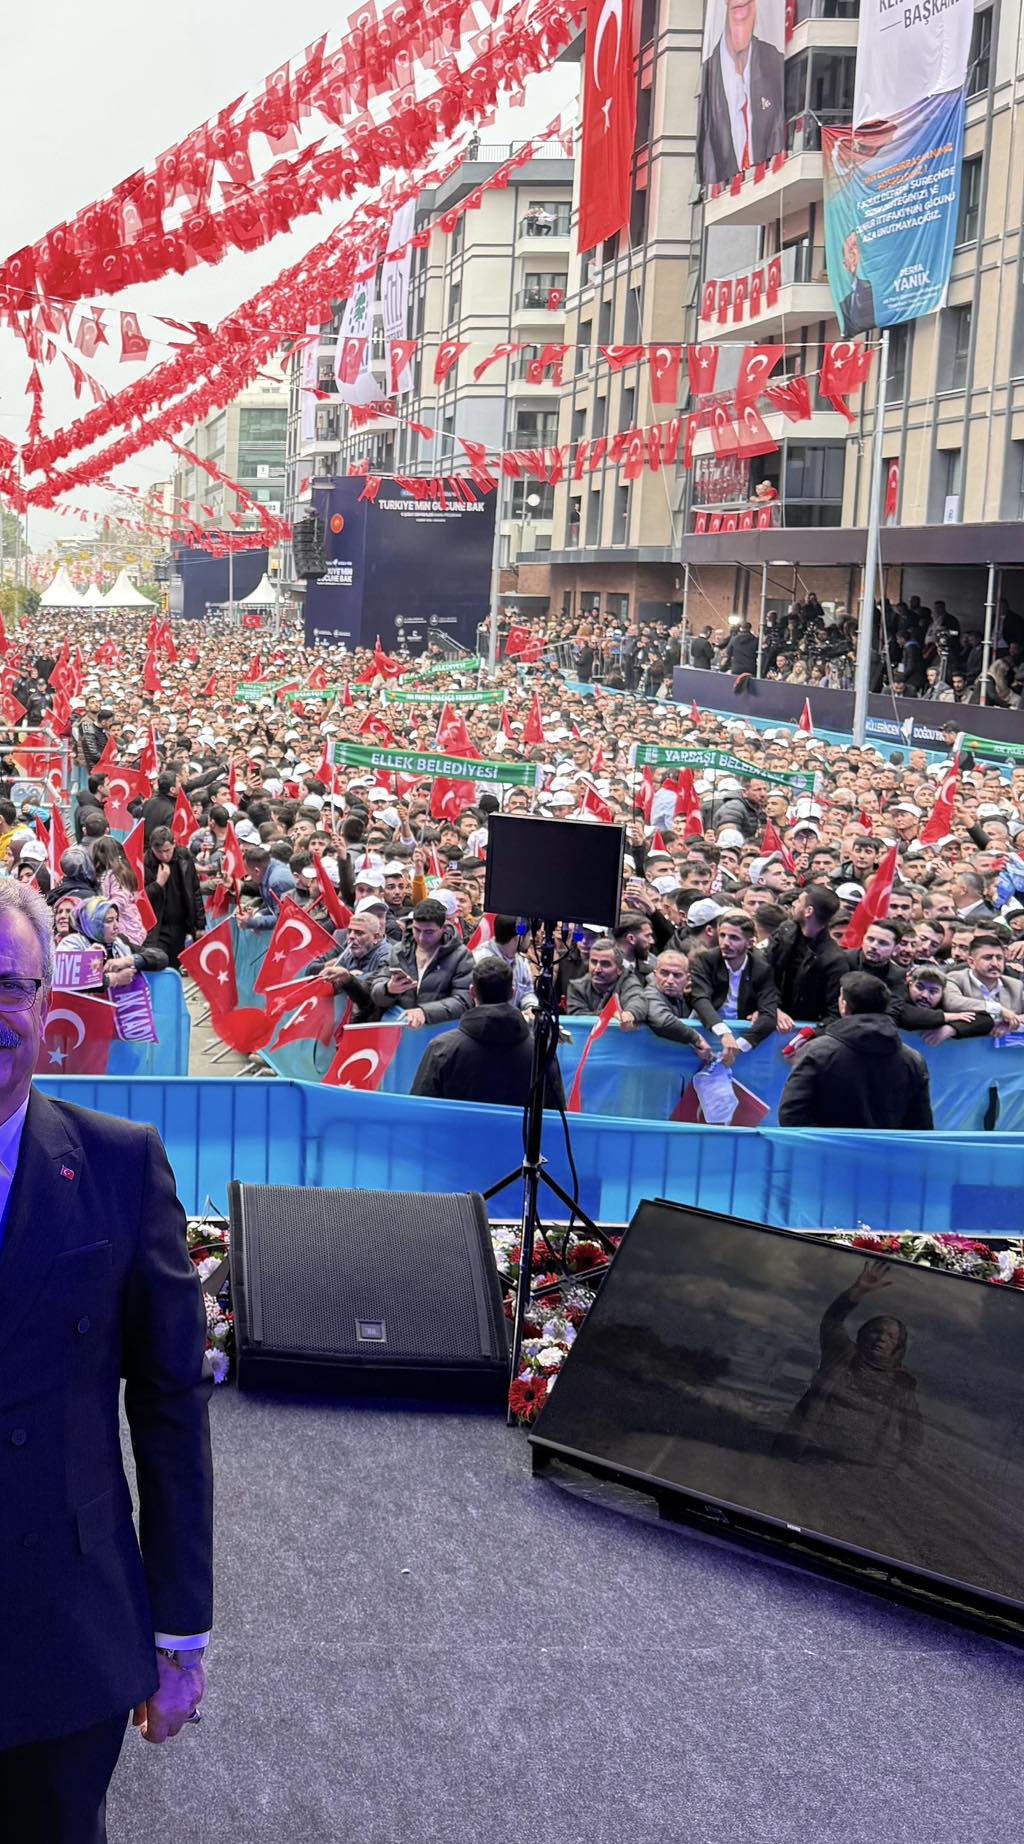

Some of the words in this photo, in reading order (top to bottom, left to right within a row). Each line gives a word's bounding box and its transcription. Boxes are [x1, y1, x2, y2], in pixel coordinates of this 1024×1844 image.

[894, 270, 931, 292] YANIK
[466, 502, 485, 511] BAK
[371, 753, 413, 769] ELLEK
[417, 757, 499, 779] BELEDİYESİ
[665, 750, 716, 767] YARBAŞI
[115, 989, 146, 1013] AK
